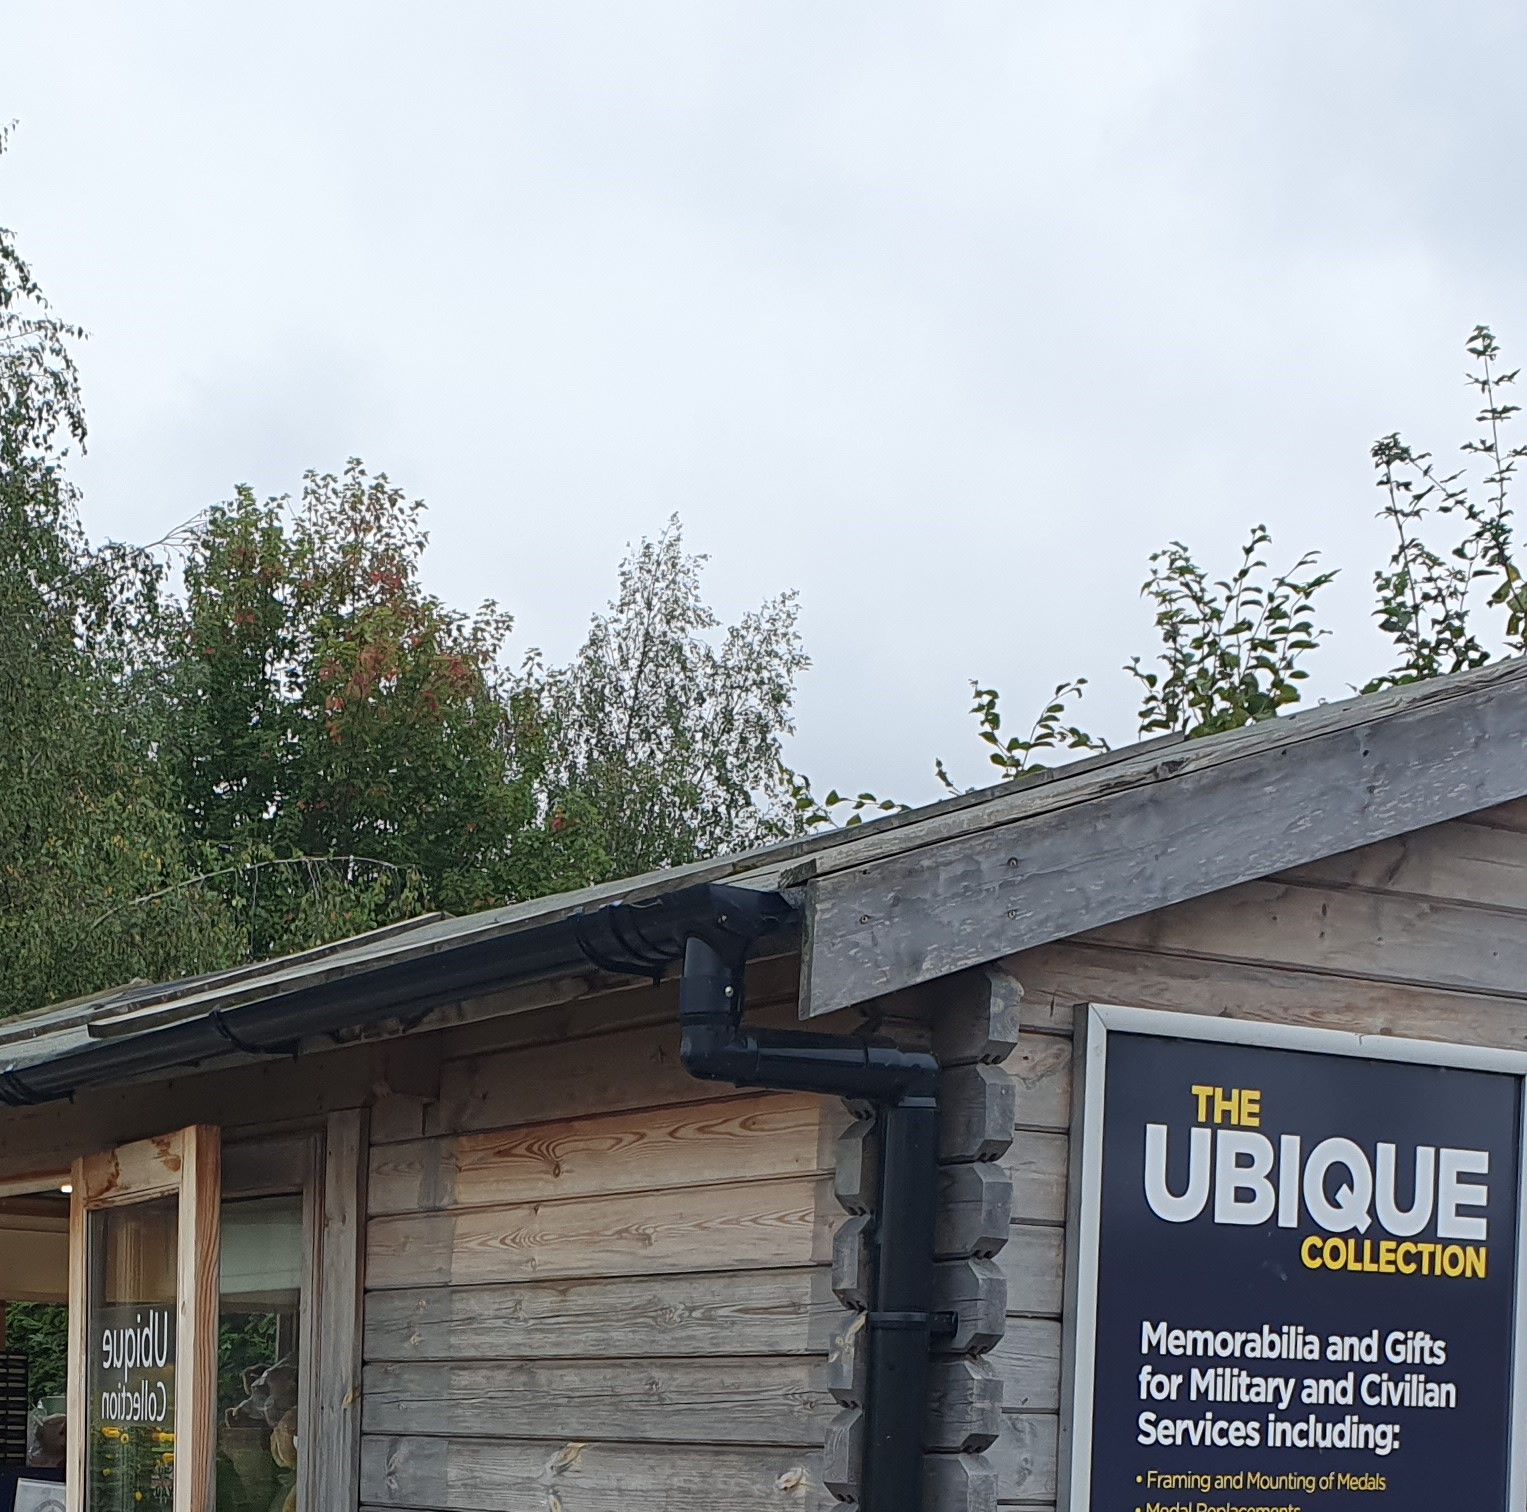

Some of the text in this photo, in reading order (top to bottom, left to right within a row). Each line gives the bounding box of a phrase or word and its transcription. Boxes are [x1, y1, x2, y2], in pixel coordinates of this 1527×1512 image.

[1191, 1085, 1261, 1127] THE
[1144, 1123, 1489, 1241] UBIQUE
[1300, 1235, 1488, 1279] COLLECTION
[1141, 1321, 1447, 1366] Memorabilia and Gifts
[1139, 1365, 1457, 1409] for Military and Civilian
[1137, 1411, 1400, 1455] Services including:
[1146, 1471, 1387, 1493] Framing and Mounting of Medals
